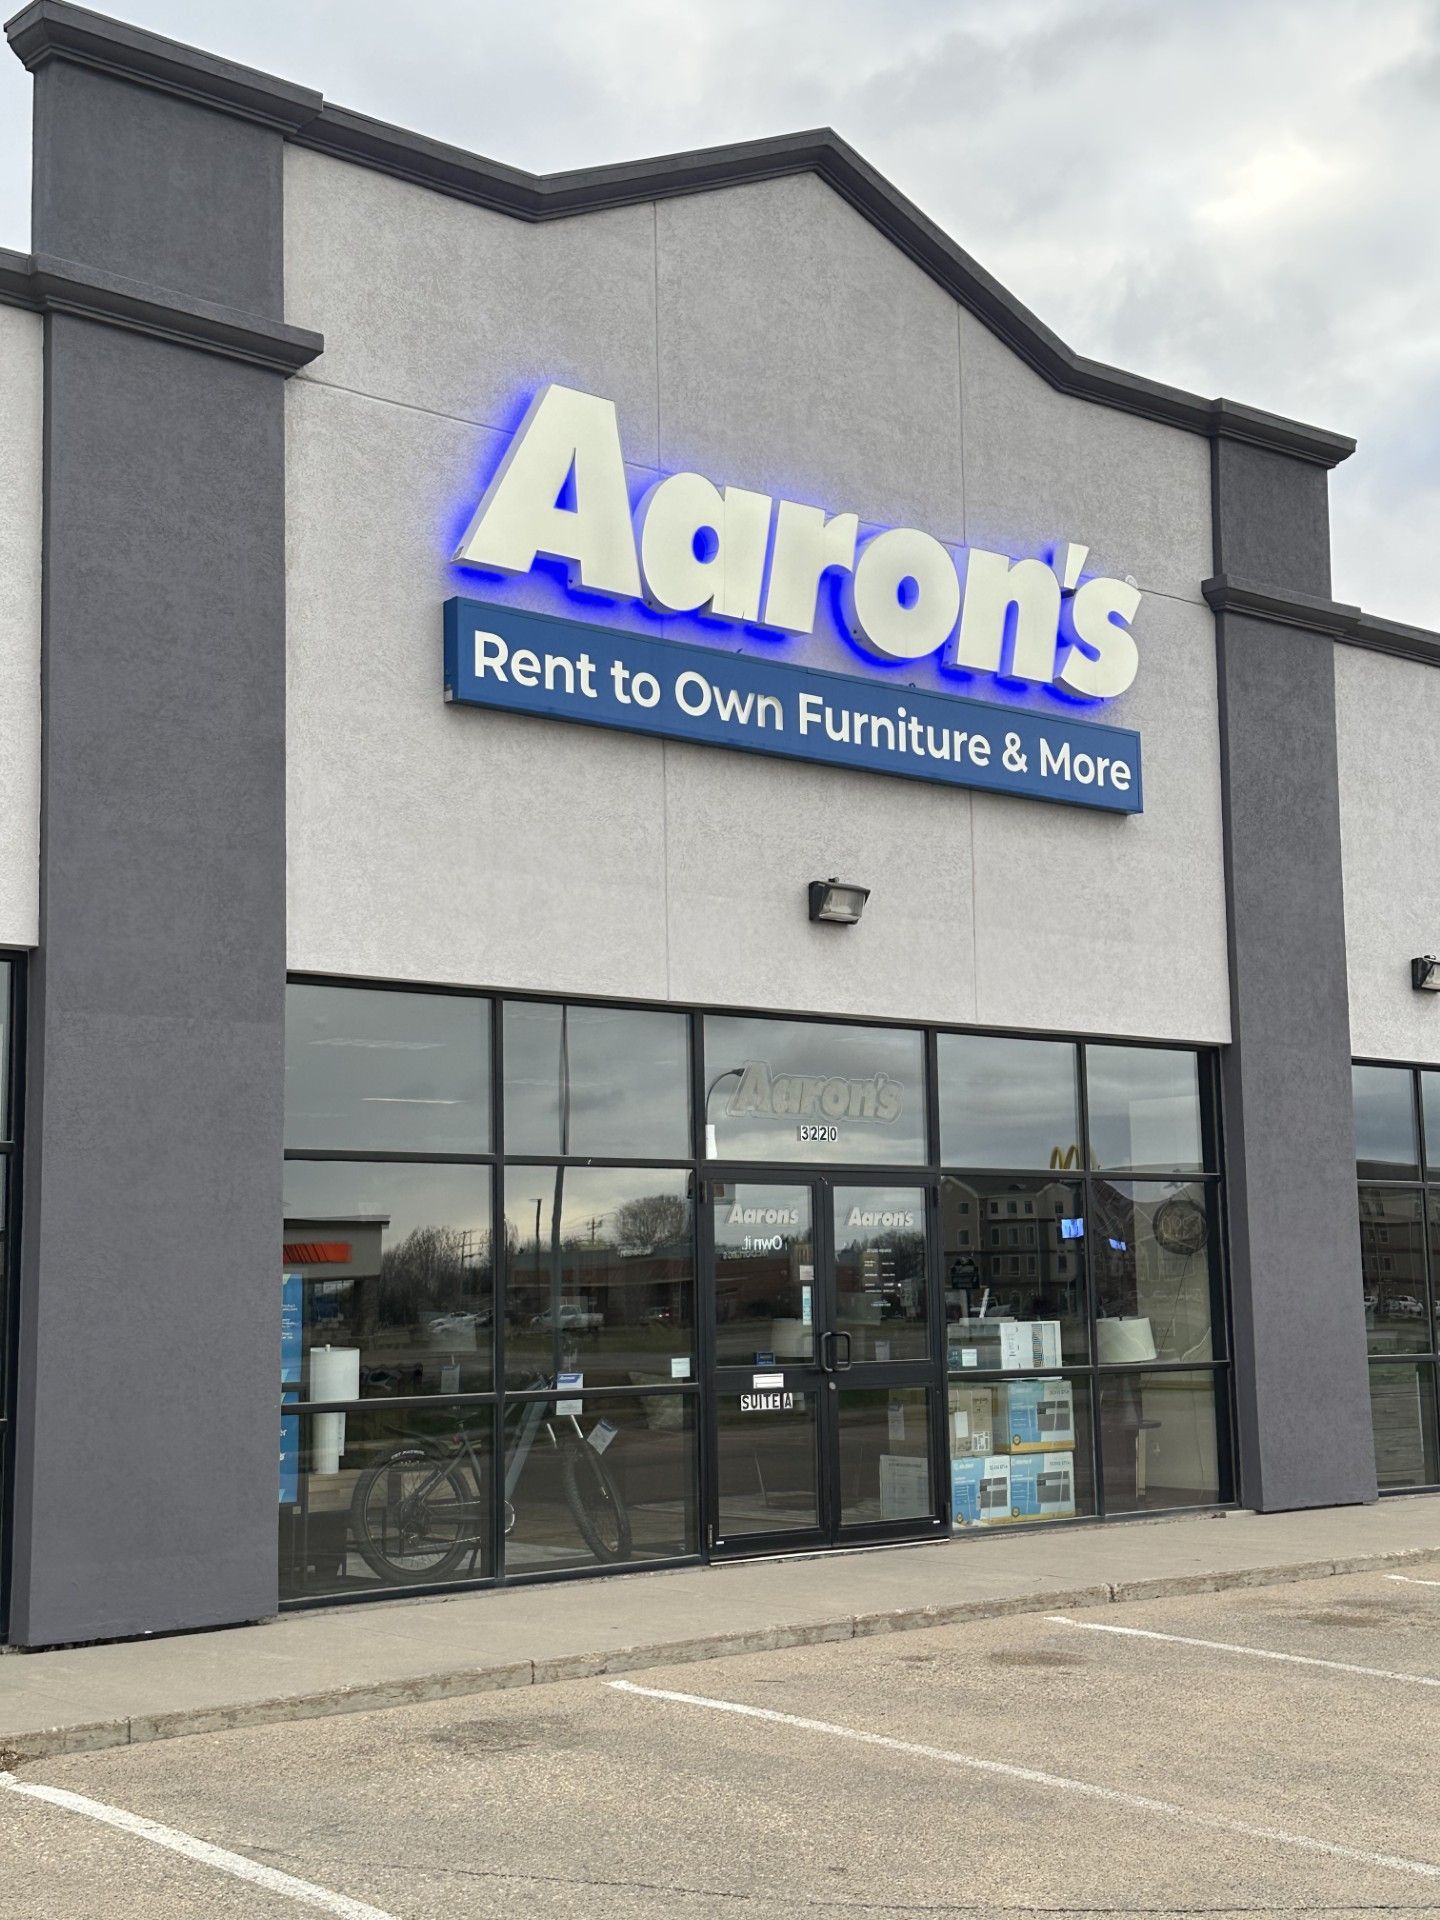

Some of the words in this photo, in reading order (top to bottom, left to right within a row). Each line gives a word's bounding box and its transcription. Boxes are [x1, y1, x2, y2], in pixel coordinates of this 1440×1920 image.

[450, 382, 1143, 698] Aaron's
[471, 629, 598, 699] Rent
[609, 658, 662, 709] to
[674, 669, 784, 732] Own
[797, 691, 991, 769] Furniture
[1000, 731, 1030, 774] &
[1038, 736, 1132, 792] More
[730, 1061, 901, 1120] Aaron's
[801, 1126, 837, 1141] 3220
[848, 1206, 914, 1227] Aaron's
[742, 1394, 780, 1409] SUITE
[784, 1393, 792, 1408] A
